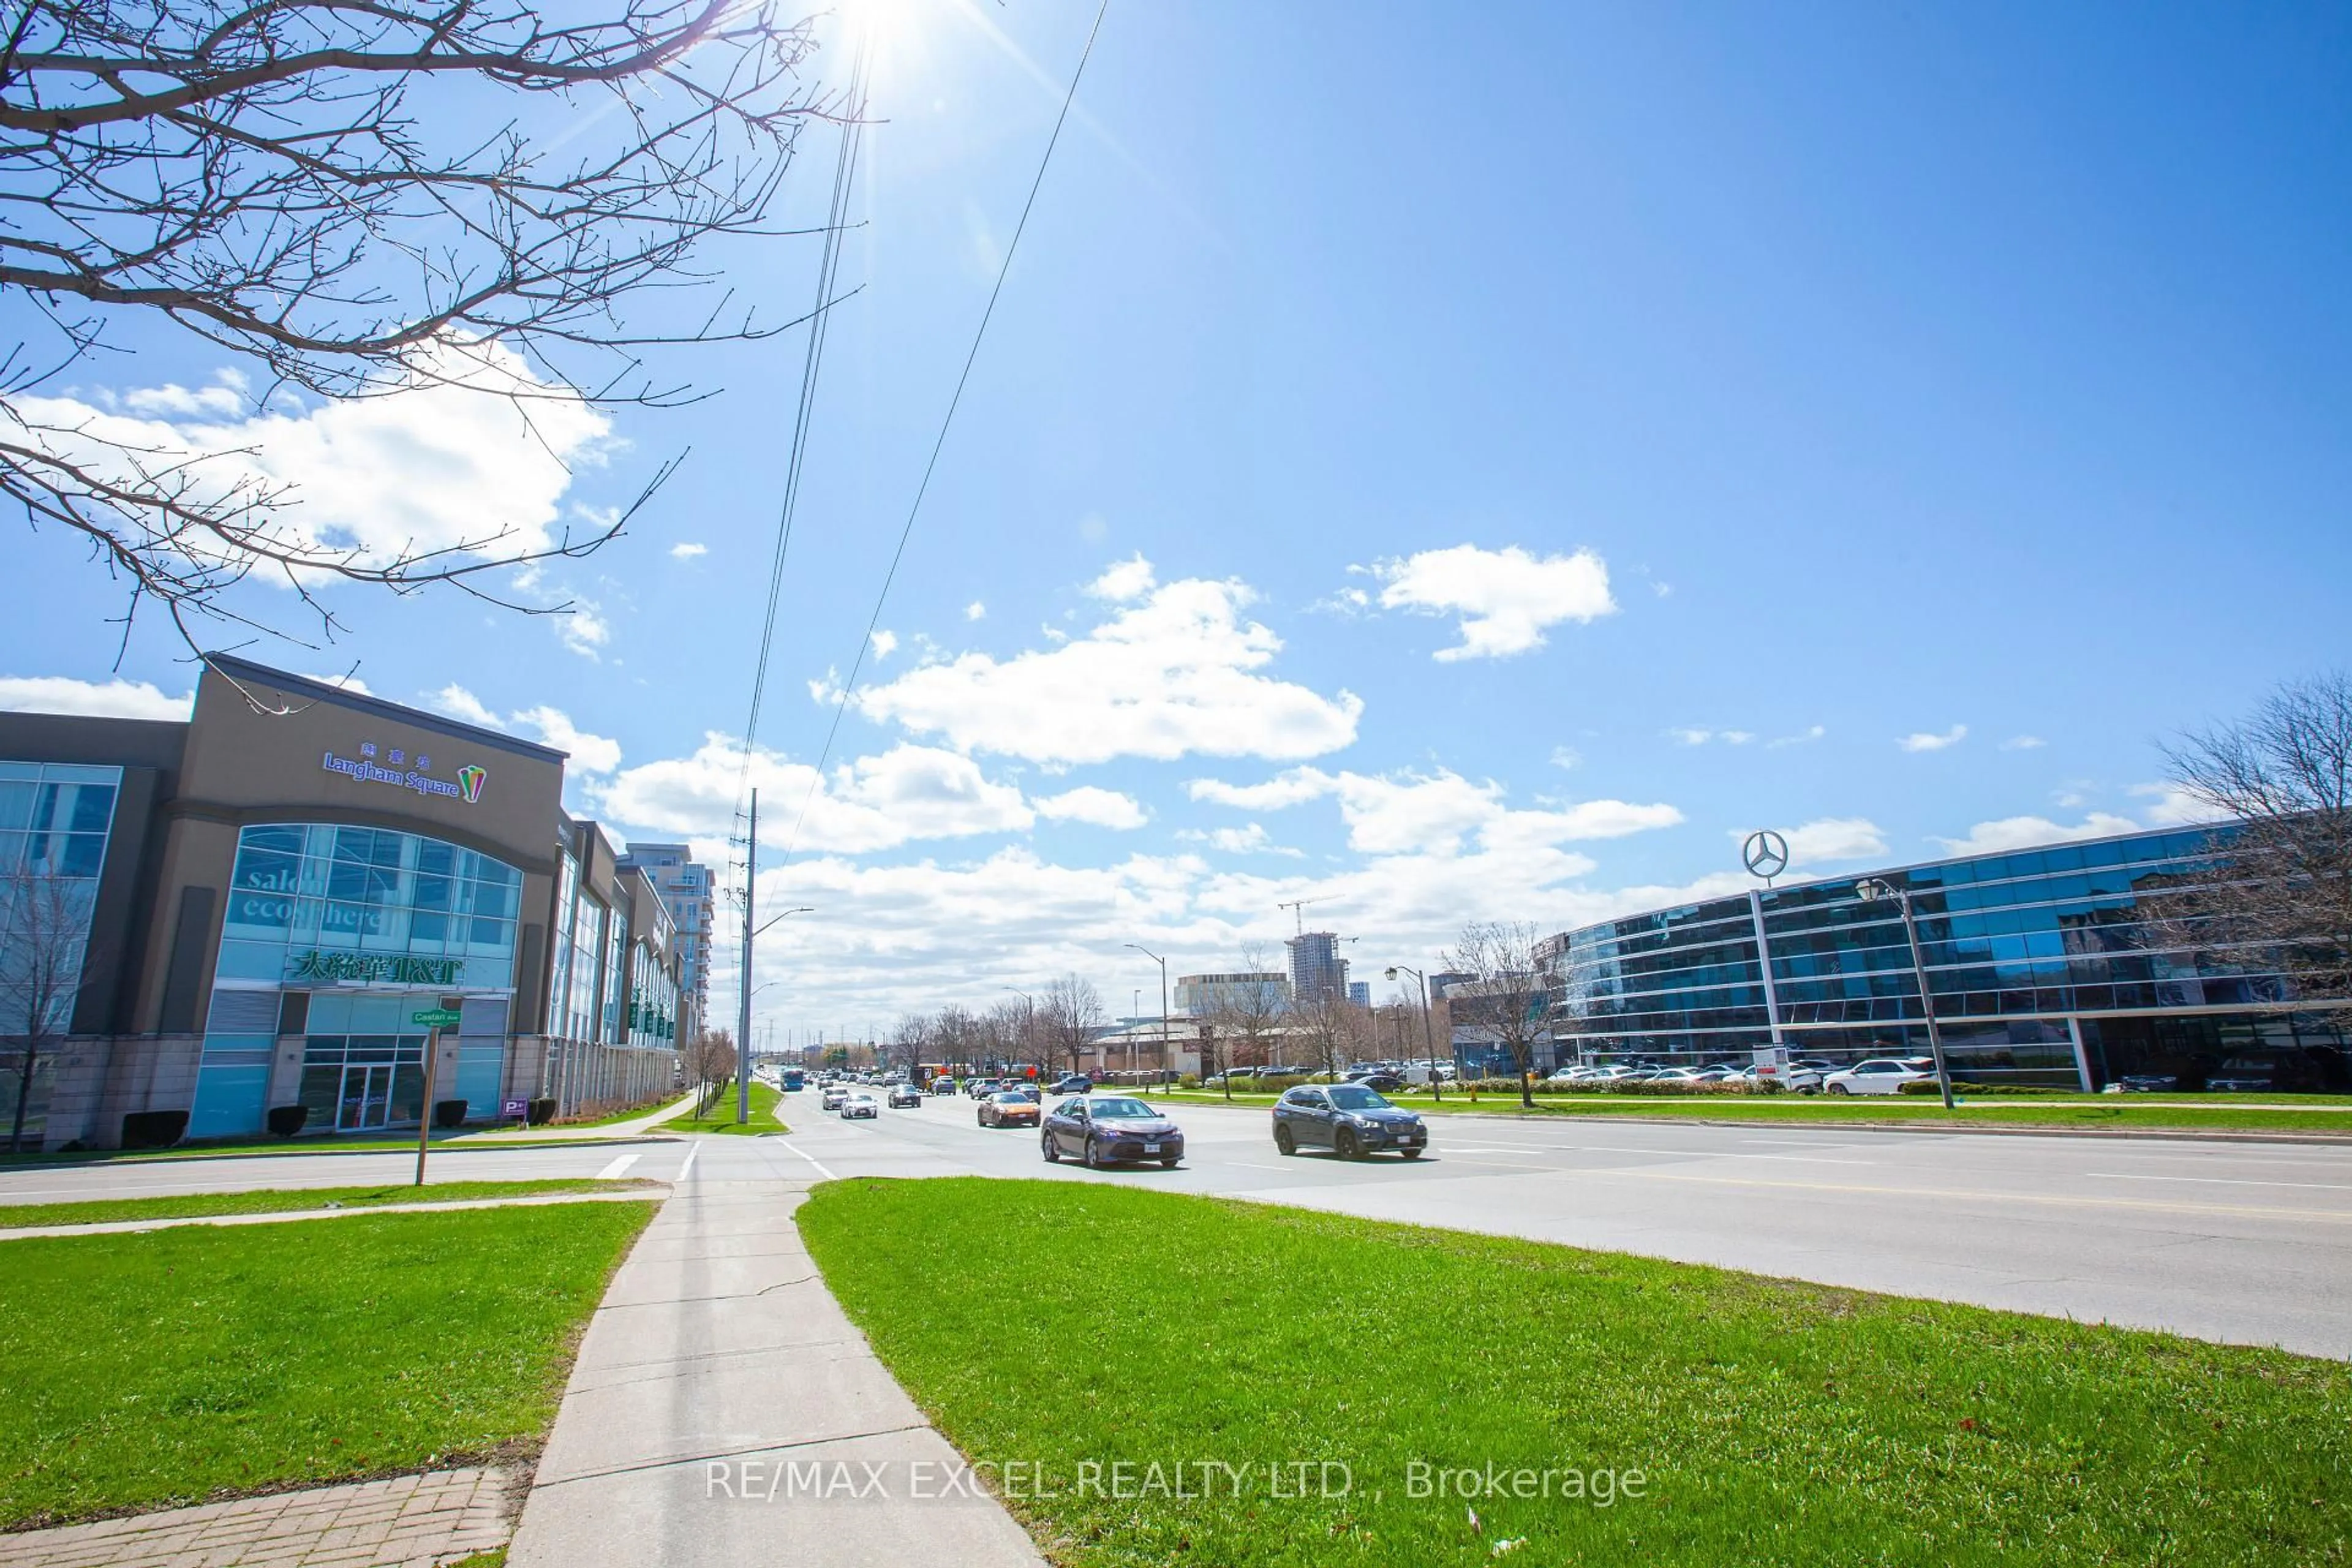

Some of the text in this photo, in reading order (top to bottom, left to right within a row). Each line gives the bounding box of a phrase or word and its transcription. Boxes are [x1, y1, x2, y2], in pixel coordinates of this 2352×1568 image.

[323, 752, 404, 786] Langham
[405, 771, 459, 796] Square
[388, 956, 462, 985] T&T
